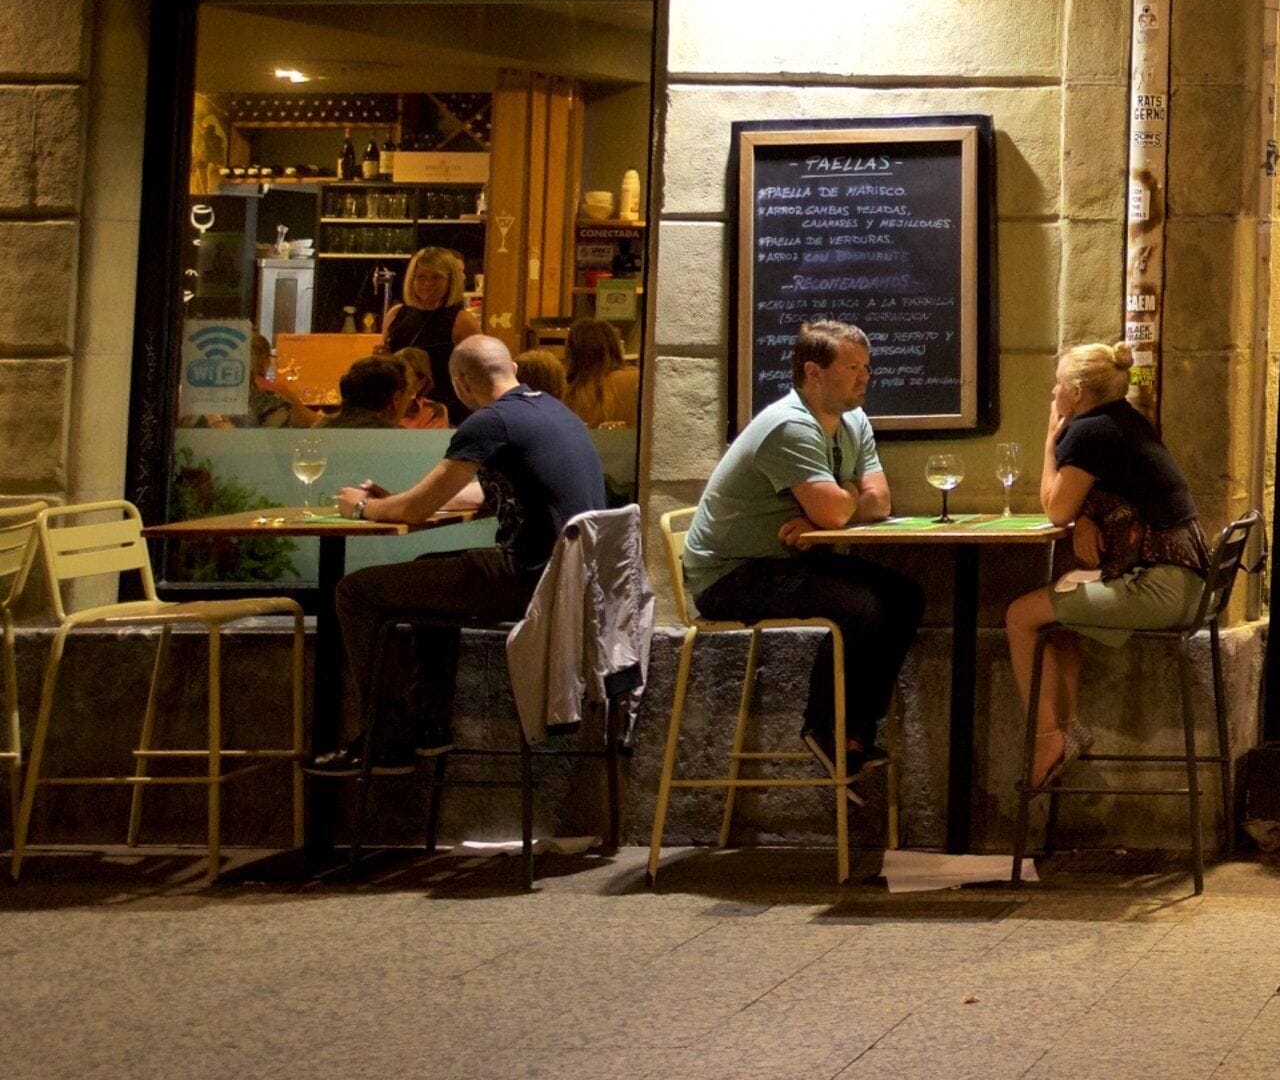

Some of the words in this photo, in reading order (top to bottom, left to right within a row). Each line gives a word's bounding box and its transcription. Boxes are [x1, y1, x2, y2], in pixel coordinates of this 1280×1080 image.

[1137, 95, 1162, 107] RATS
[818, 187, 839, 198] DE
[580, 229, 639, 238] CONECTADA
[806, 237, 823, 246] DE
[944, 330, 954, 342] Y
